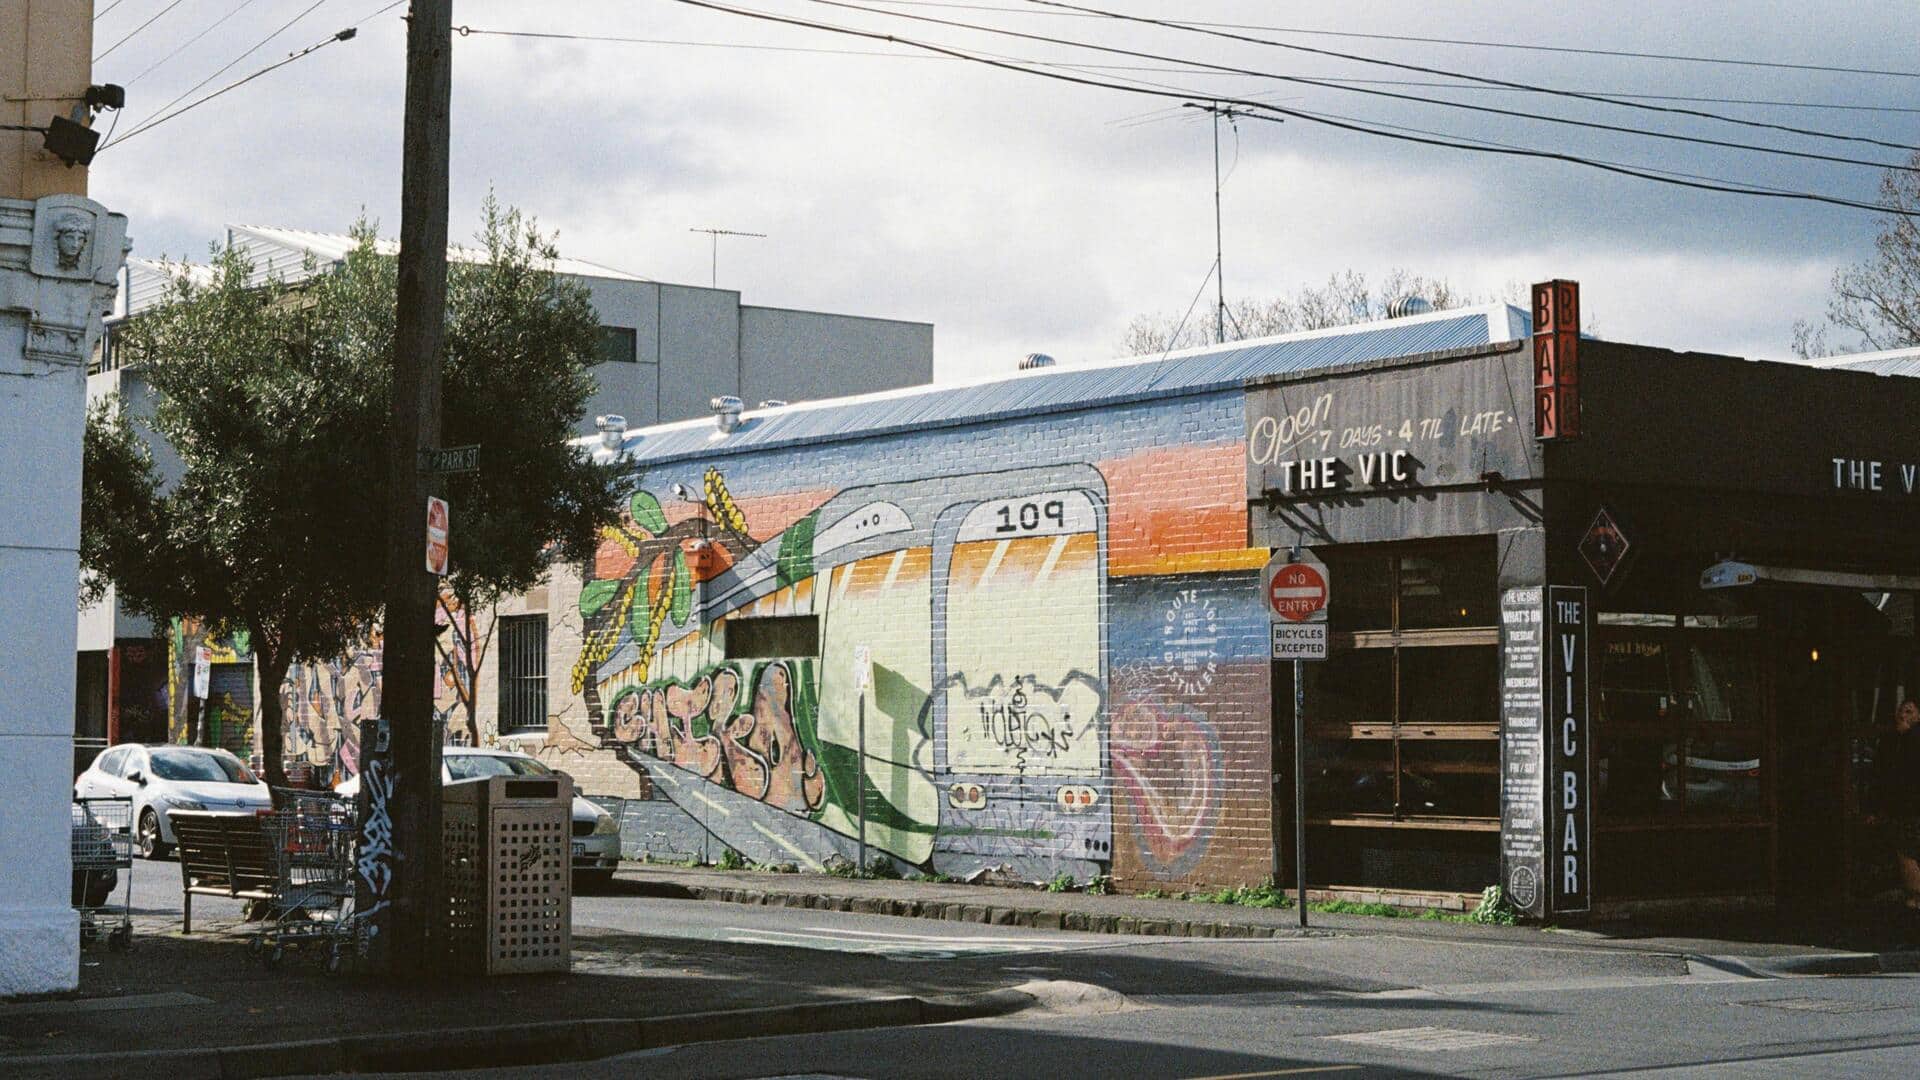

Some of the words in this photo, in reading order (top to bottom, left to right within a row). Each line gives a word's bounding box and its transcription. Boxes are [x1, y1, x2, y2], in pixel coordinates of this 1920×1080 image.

[1537, 288, 1553, 437] BAR
[1250, 393, 1333, 465] Open
[1339, 424, 1382, 449] DAYS
[1420, 418, 1444, 440] TIL
[441, 450, 464, 470] PARK
[466, 448, 478, 467] ST
[1280, 456, 1336, 491] THE
[1358, 449, 1407, 485] VIC
[1832, 458, 1882, 491] THE
[1902, 464, 1920, 494] V
[996, 500, 1064, 533] 109
[1289, 573, 1306, 585] NO
[1278, 600, 1318, 612] ENTRY
[1556, 601, 1580, 625] THE
[1275, 629, 1324, 639] BICYCLES
[1509, 630, 1535, 641] TUESDAY
[1275, 644, 1324, 653] EXCEPTED
[1505, 677, 1539, 688] WEDNESDAY
[1562, 633, 1577, 757] VIC
[1563, 771, 1578, 894] BAR
